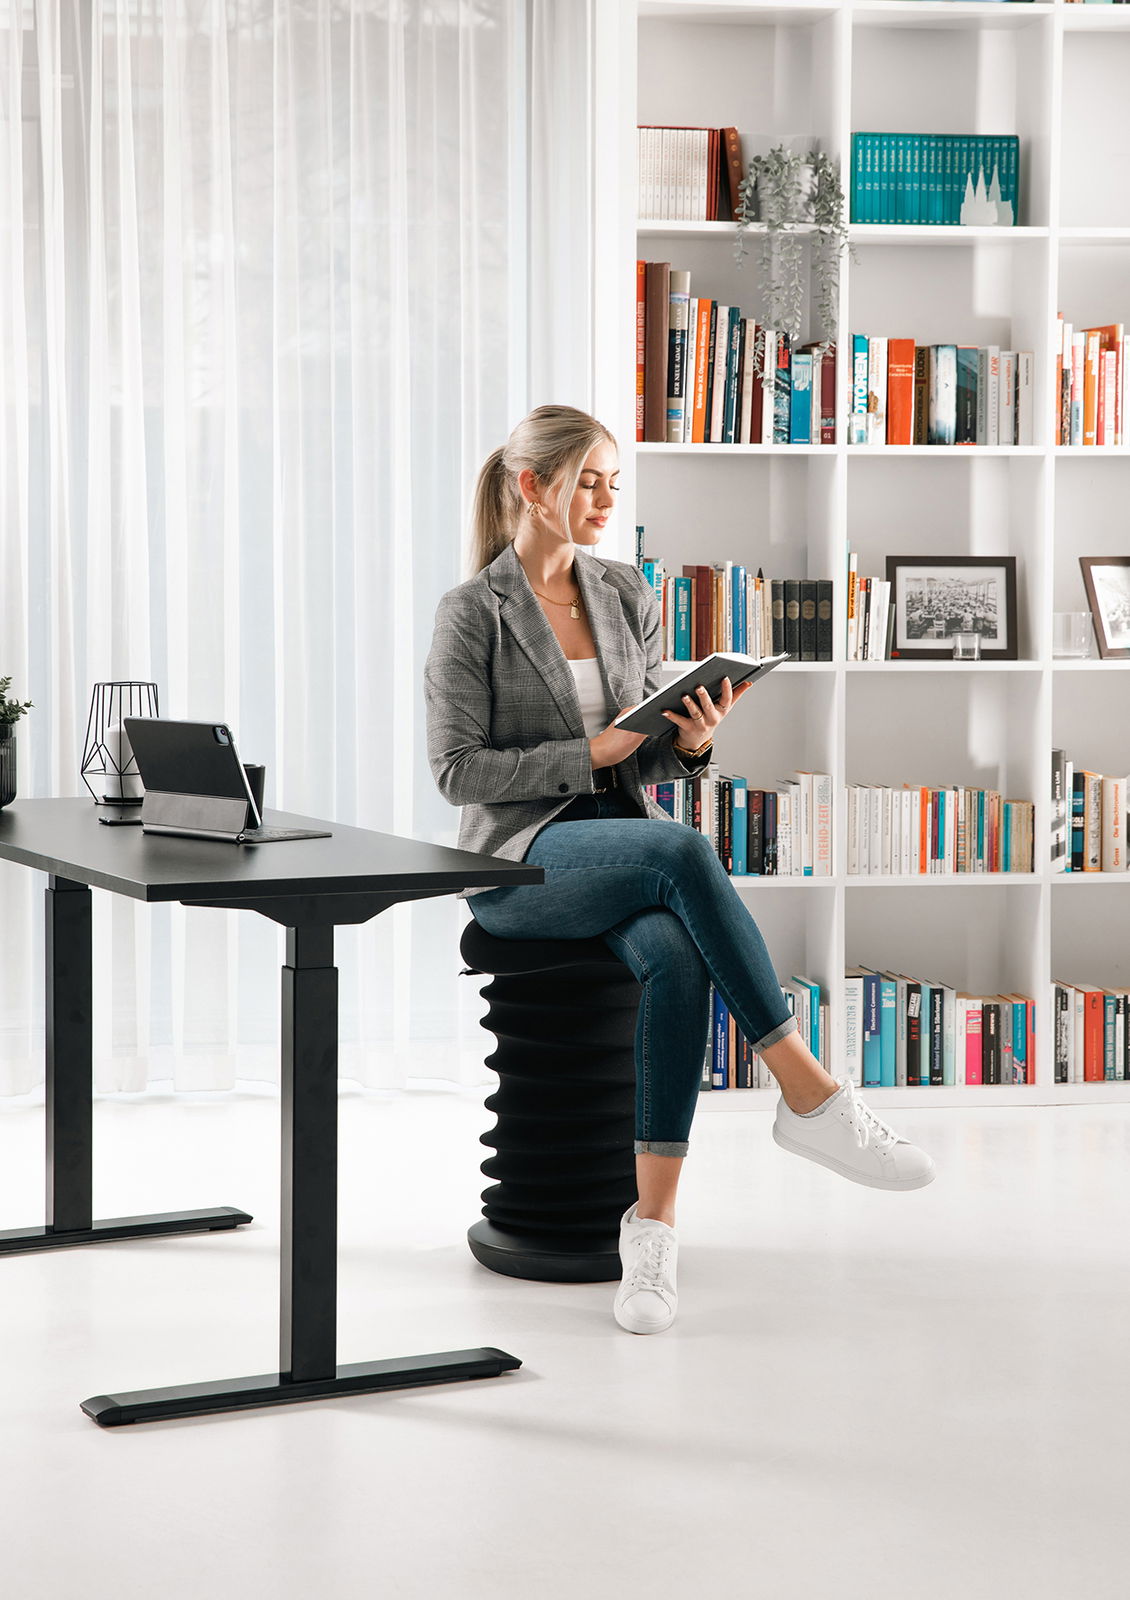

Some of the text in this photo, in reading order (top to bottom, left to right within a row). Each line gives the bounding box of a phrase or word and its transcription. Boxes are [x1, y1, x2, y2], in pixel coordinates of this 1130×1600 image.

[917, 349, 925, 378] DUDEN
[817, 804, 829, 860] TREND-ZEIT
[847, 1005, 856, 1057] MARKETING
